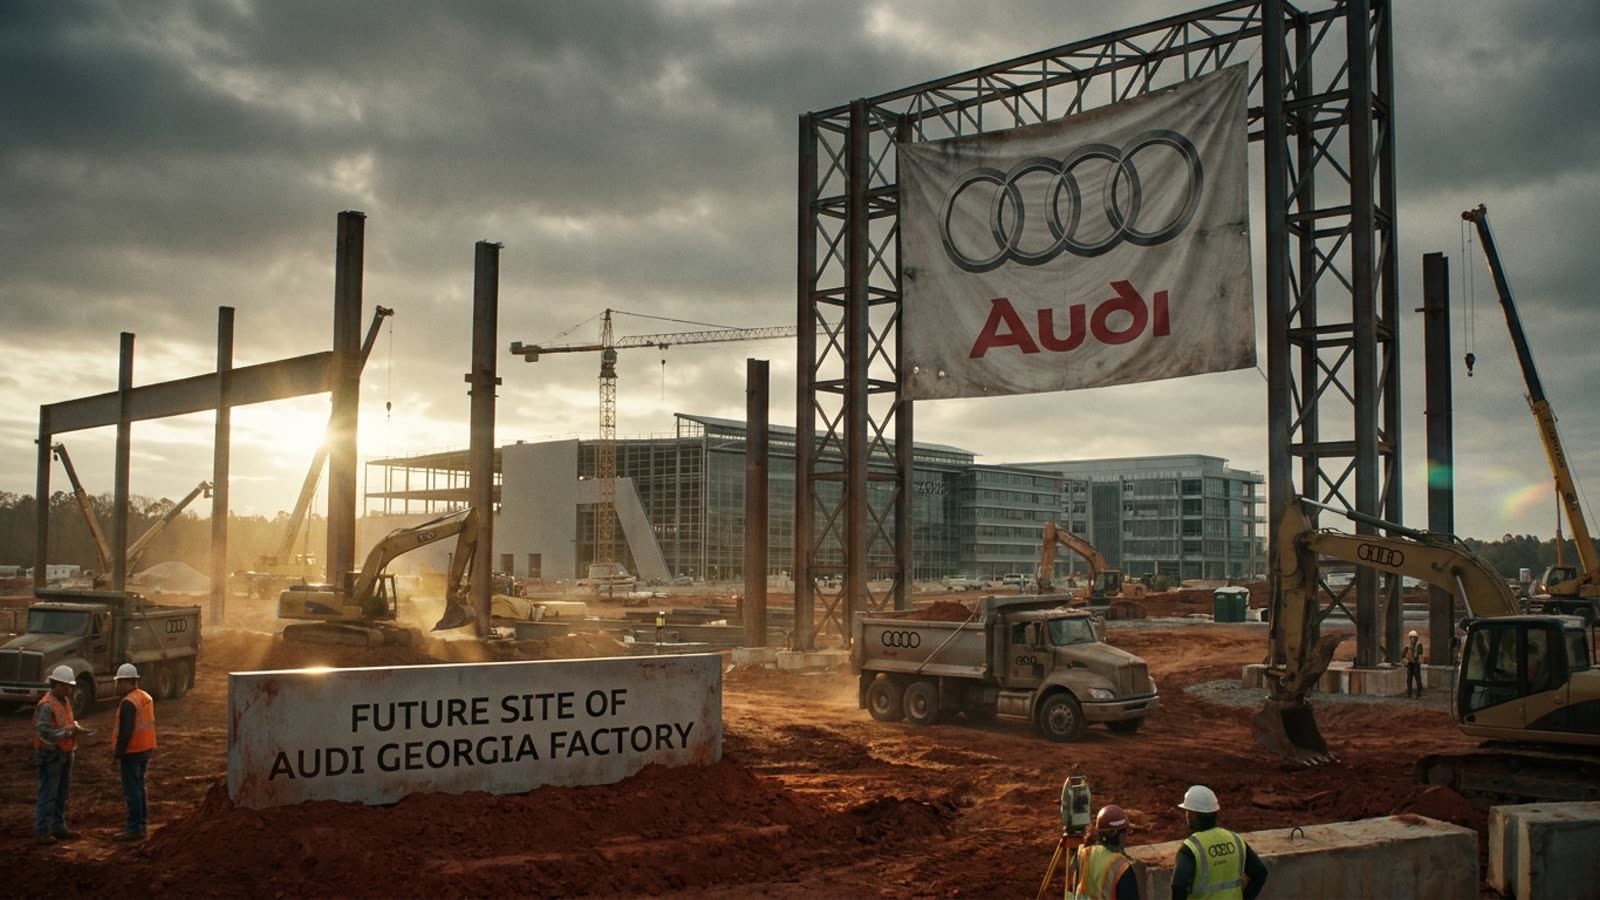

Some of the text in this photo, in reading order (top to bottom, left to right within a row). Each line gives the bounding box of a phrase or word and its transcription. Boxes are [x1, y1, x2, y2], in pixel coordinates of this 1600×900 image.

[351, 688, 628, 733] FUTURE SITE OF
[269, 721, 695, 781] AUDI GEORGIA FACTORY
